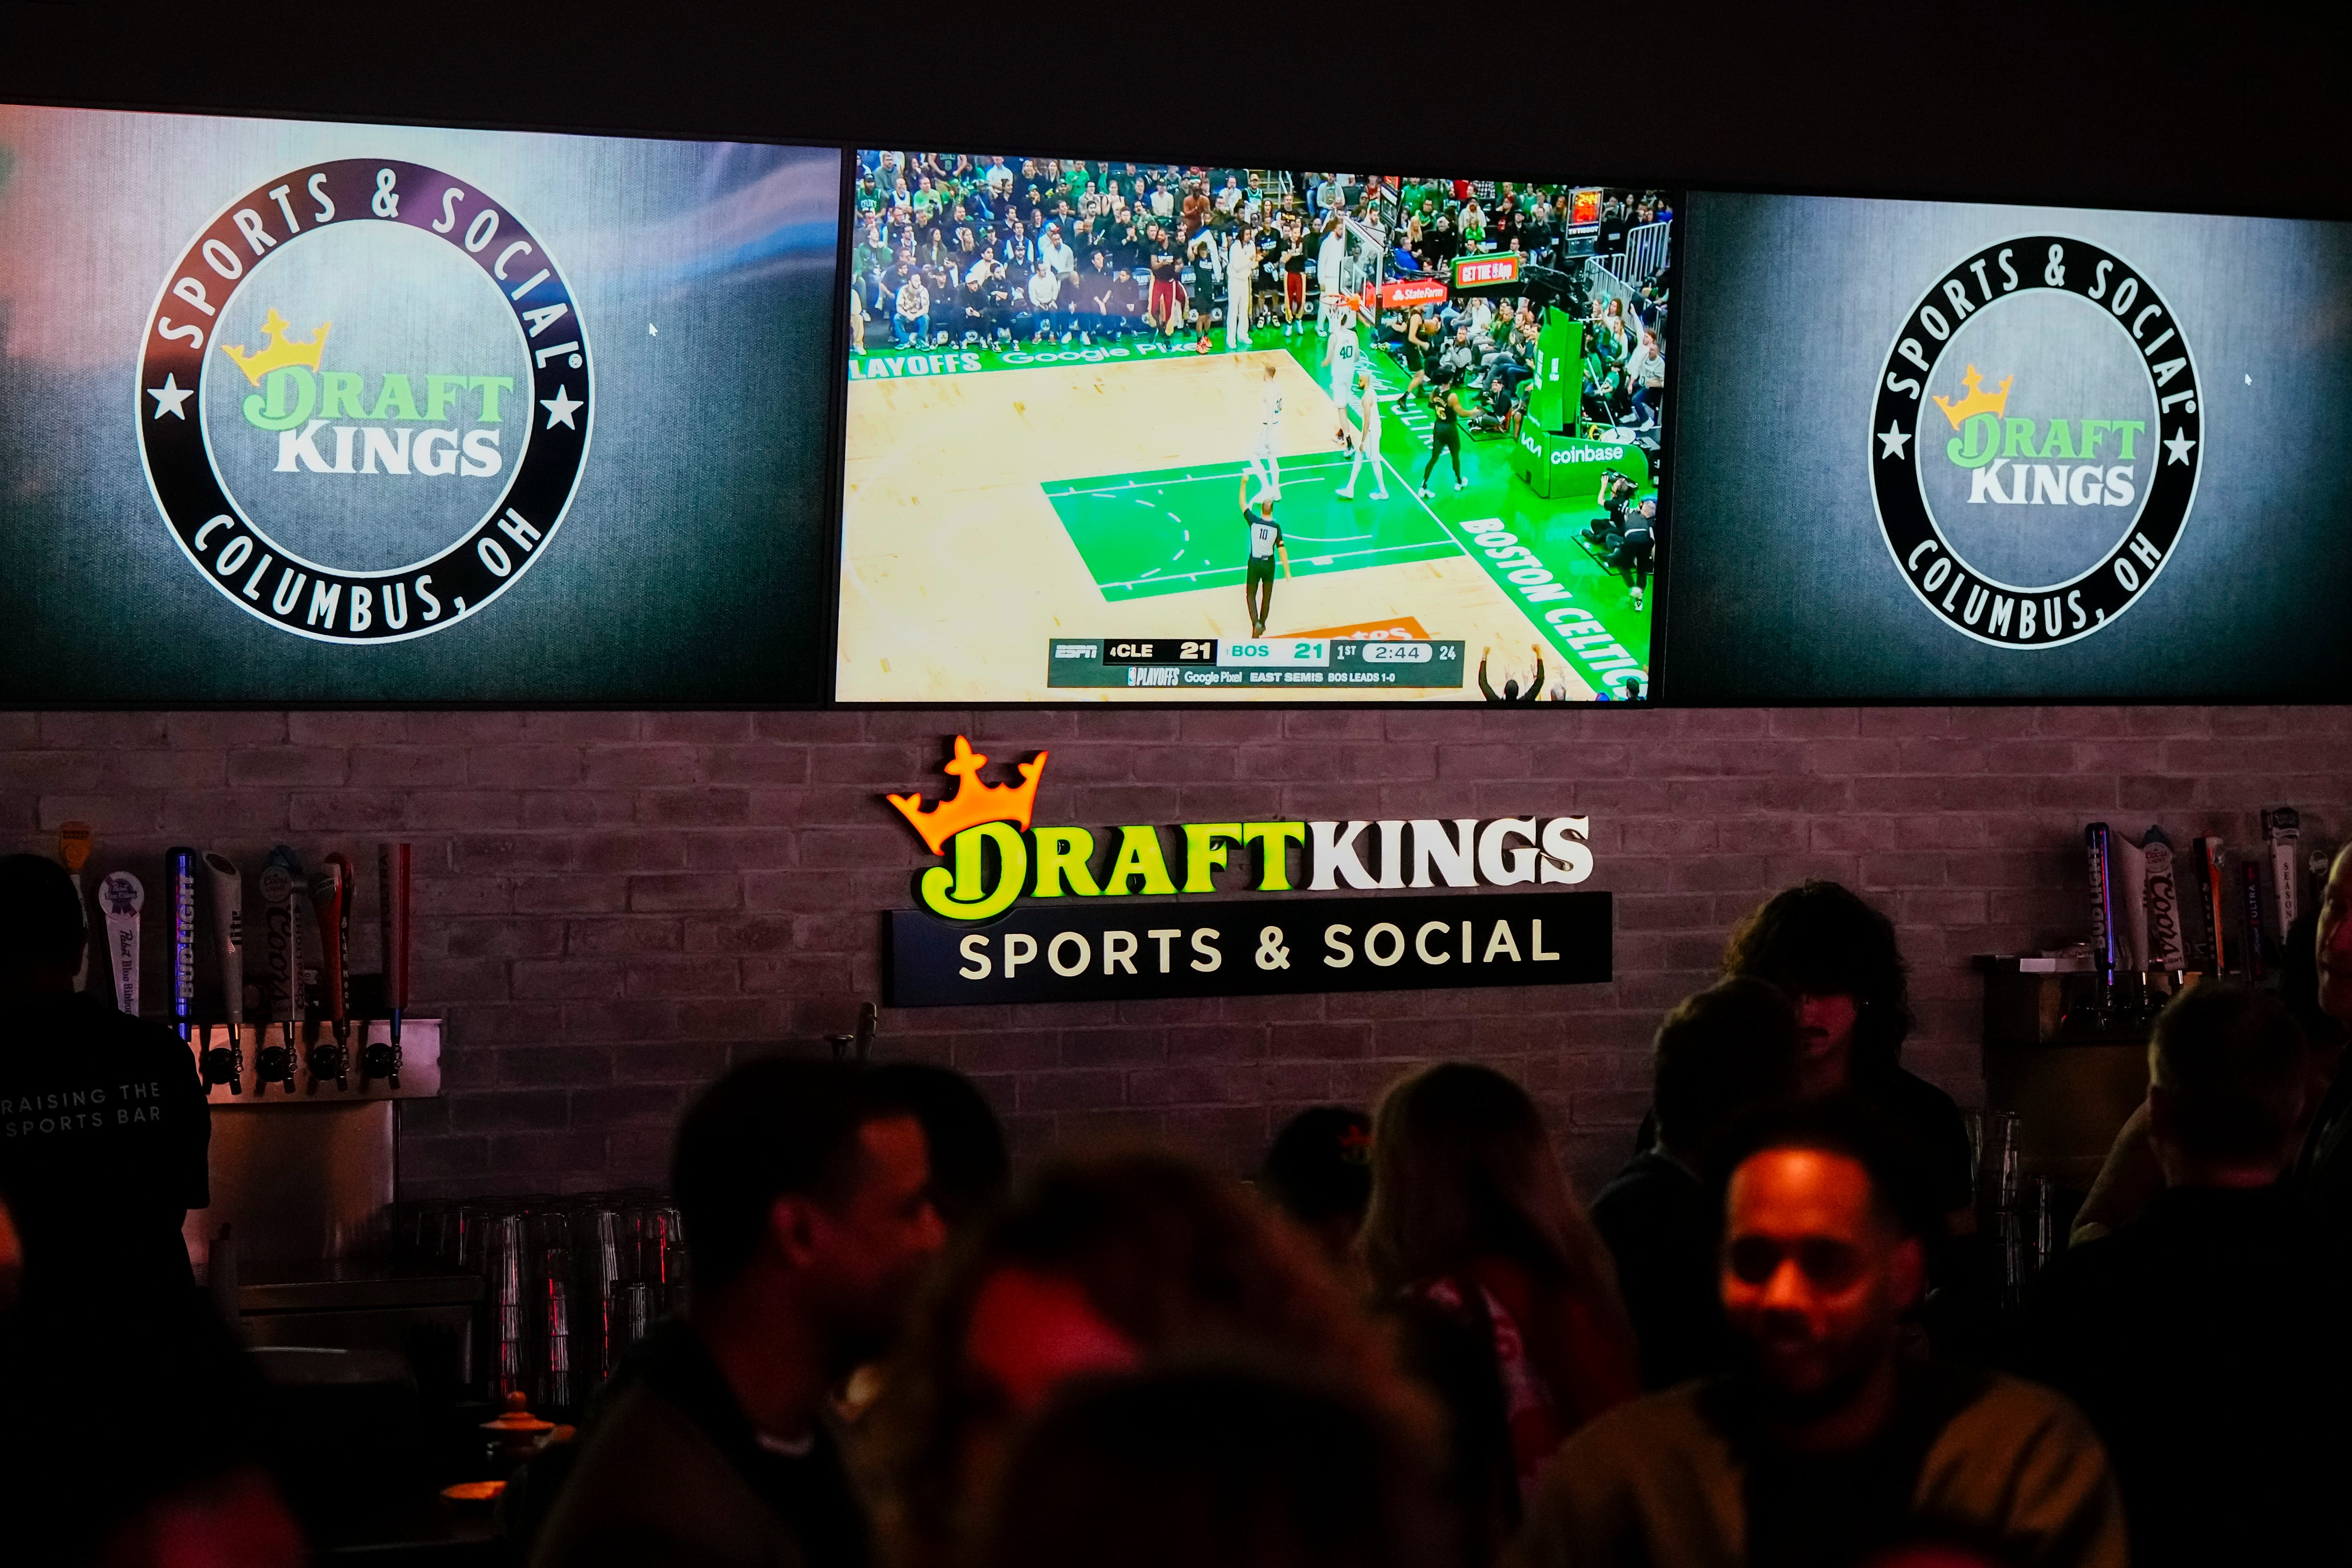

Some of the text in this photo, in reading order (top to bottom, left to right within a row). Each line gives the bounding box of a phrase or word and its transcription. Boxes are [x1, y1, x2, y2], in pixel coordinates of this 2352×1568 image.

[158, 172, 335, 349] SPORTS
[372, 168, 399, 217] &
[1462, 266, 1477, 282] GET
[1478, 263, 1492, 281] THE
[1886, 248, 2019, 400] SPORTS
[2044, 243, 2066, 286] &
[1002, 342, 1197, 365] Google Pixe
[1340, 345, 1353, 359] 40
[241, 365, 514, 431] DRAFT
[272, 419, 502, 477] KINGS
[1550, 444, 1624, 465] coinbase
[1946, 412, 2145, 468] DRAFT
[1967, 458, 2135, 507] KINGS
[1259, 528, 1269, 540] 10
[194, 506, 541, 631] COLUMBUS, OH
[1908, 531, 2162, 639] COLUMBUS, OH
[1459, 517, 1650, 700] BOSTON CELTIC
[1055, 644, 1098, 658] ESPN
[1116, 644, 1154, 658] CLE
[1179, 642, 1211, 659] 21
[1232, 645, 1269, 657] BOS
[1294, 643, 1323, 659] 21
[1337, 645, 1456, 660] 1ST 2:44 24
[1137, 667, 1396, 686] PLAYOFFS Google Pixel EAST SEMIS BOS LEADS 1-0
[2149, 873, 2178, 956] Coors
[2248, 884, 2258, 919] ULTRA
[119, 929, 133, 957] Pabst
[178, 875, 195, 998] BUD LIGHT
[2091, 906, 2106, 950] BUD
[267, 906, 292, 1004] Coors
[959, 919, 1561, 981] SPORTS & SOCIAL
[122, 960, 132, 981] Blue
[1, 1081, 160, 1115] RAISING THE
[5, 1105, 160, 1138] SPORTS BAR
